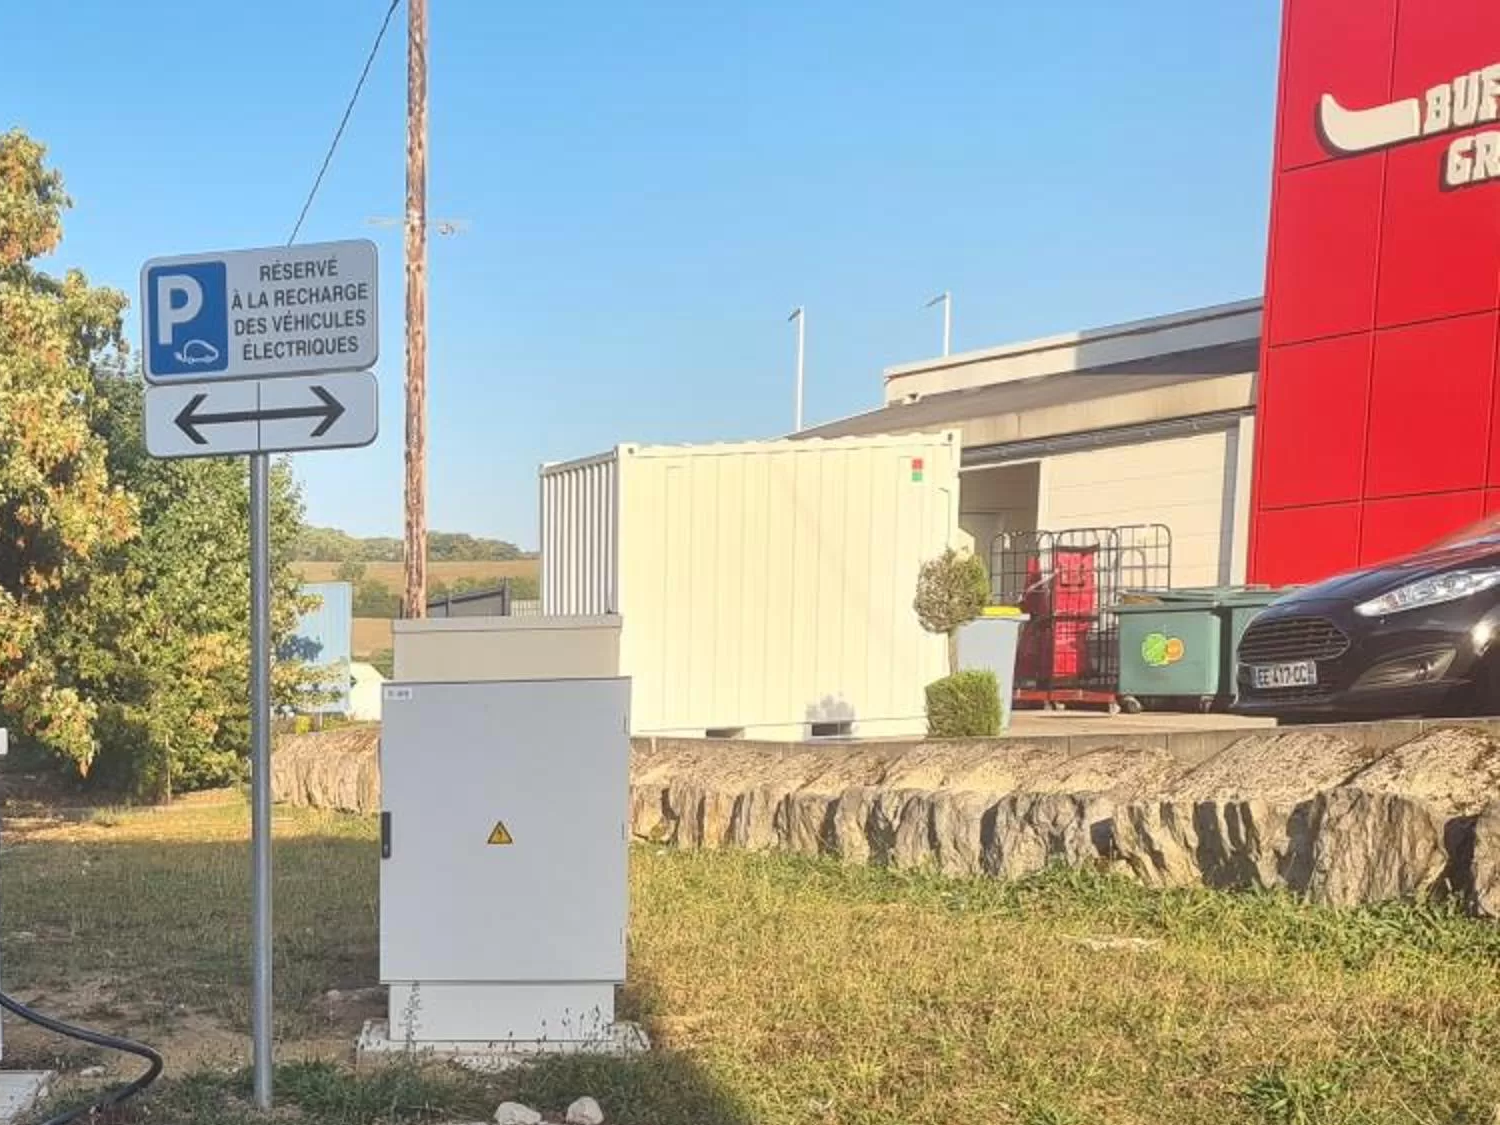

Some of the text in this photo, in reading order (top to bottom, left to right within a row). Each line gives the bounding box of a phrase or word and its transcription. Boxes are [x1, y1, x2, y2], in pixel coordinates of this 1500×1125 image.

[259, 256, 338, 282] RÉSERVÉ
[157, 274, 203, 346] P
[231, 283, 369, 311] À LA RECHARGE
[234, 309, 366, 337] DES VÉHICULES
[243, 335, 359, 362] ÉLECTRIQUES
